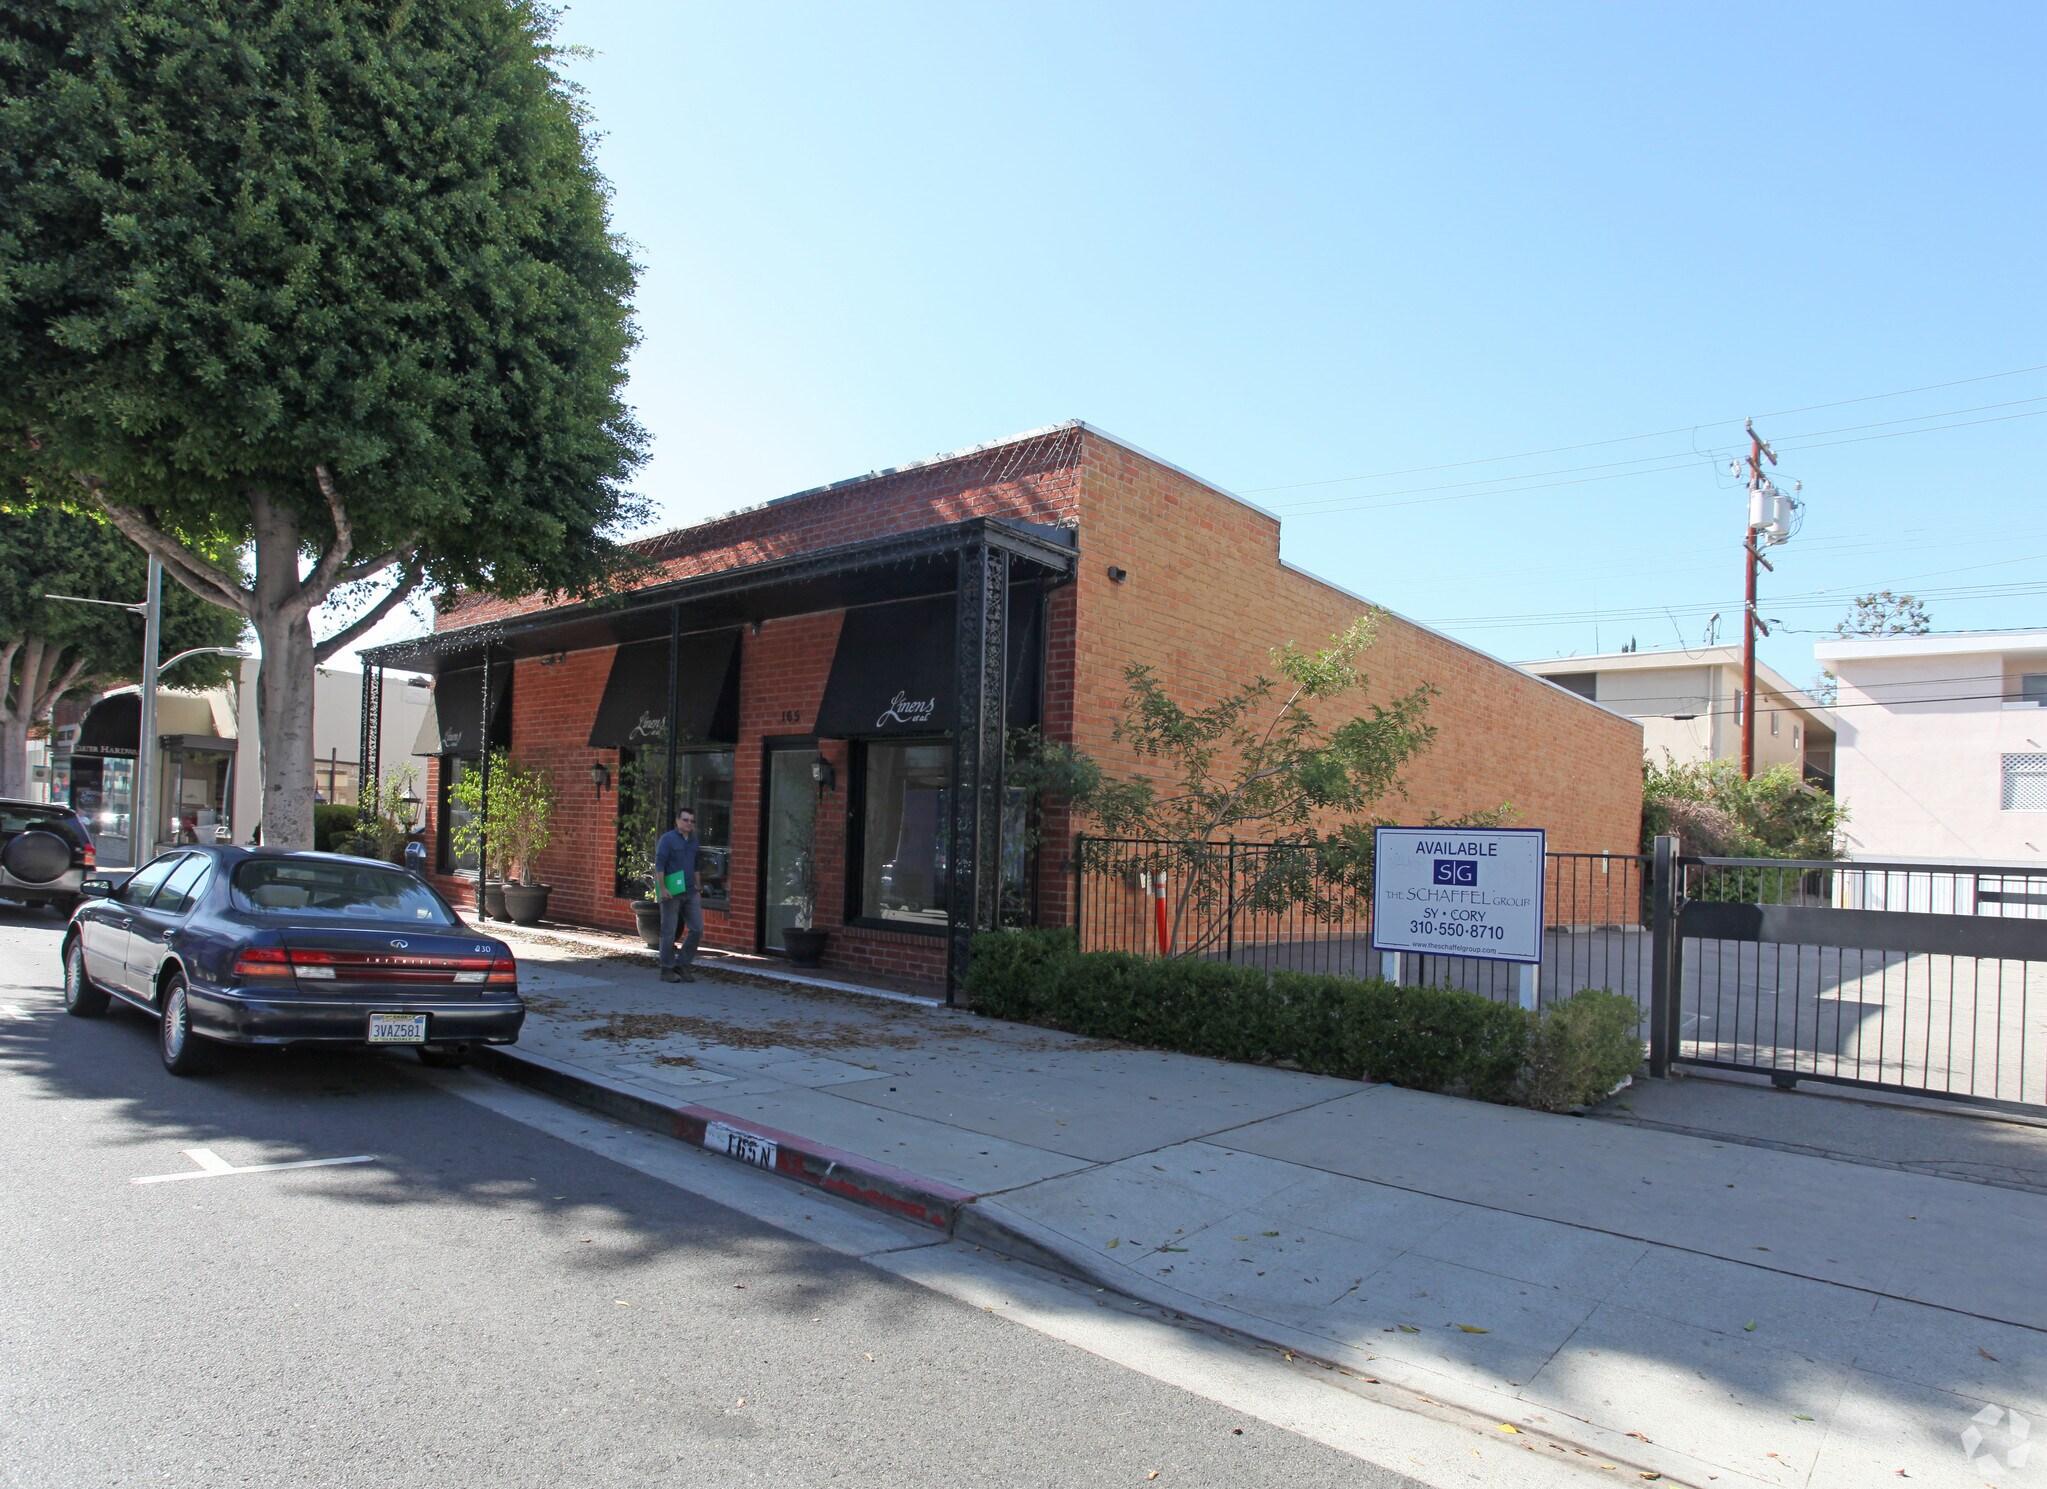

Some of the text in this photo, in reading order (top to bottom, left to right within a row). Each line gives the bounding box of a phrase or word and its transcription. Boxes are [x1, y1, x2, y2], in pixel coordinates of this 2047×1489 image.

[782, 710, 800, 722] 165
[876, 690, 935, 728] Linens
[629, 710, 666, 740] Linens
[100, 745, 138, 756] HARDWA
[1415, 841, 1498, 857] AVAILABLE
[1385, 887, 1531, 907] THE SCHAFFEL GROUP
[1423, 907, 1486, 922] SY CORY
[1412, 941, 1497, 955] www.theschaffelgroup.com
[366, 957, 432, 965] INFINITI
[373, 1024, 421, 1037] 3VAZ581
